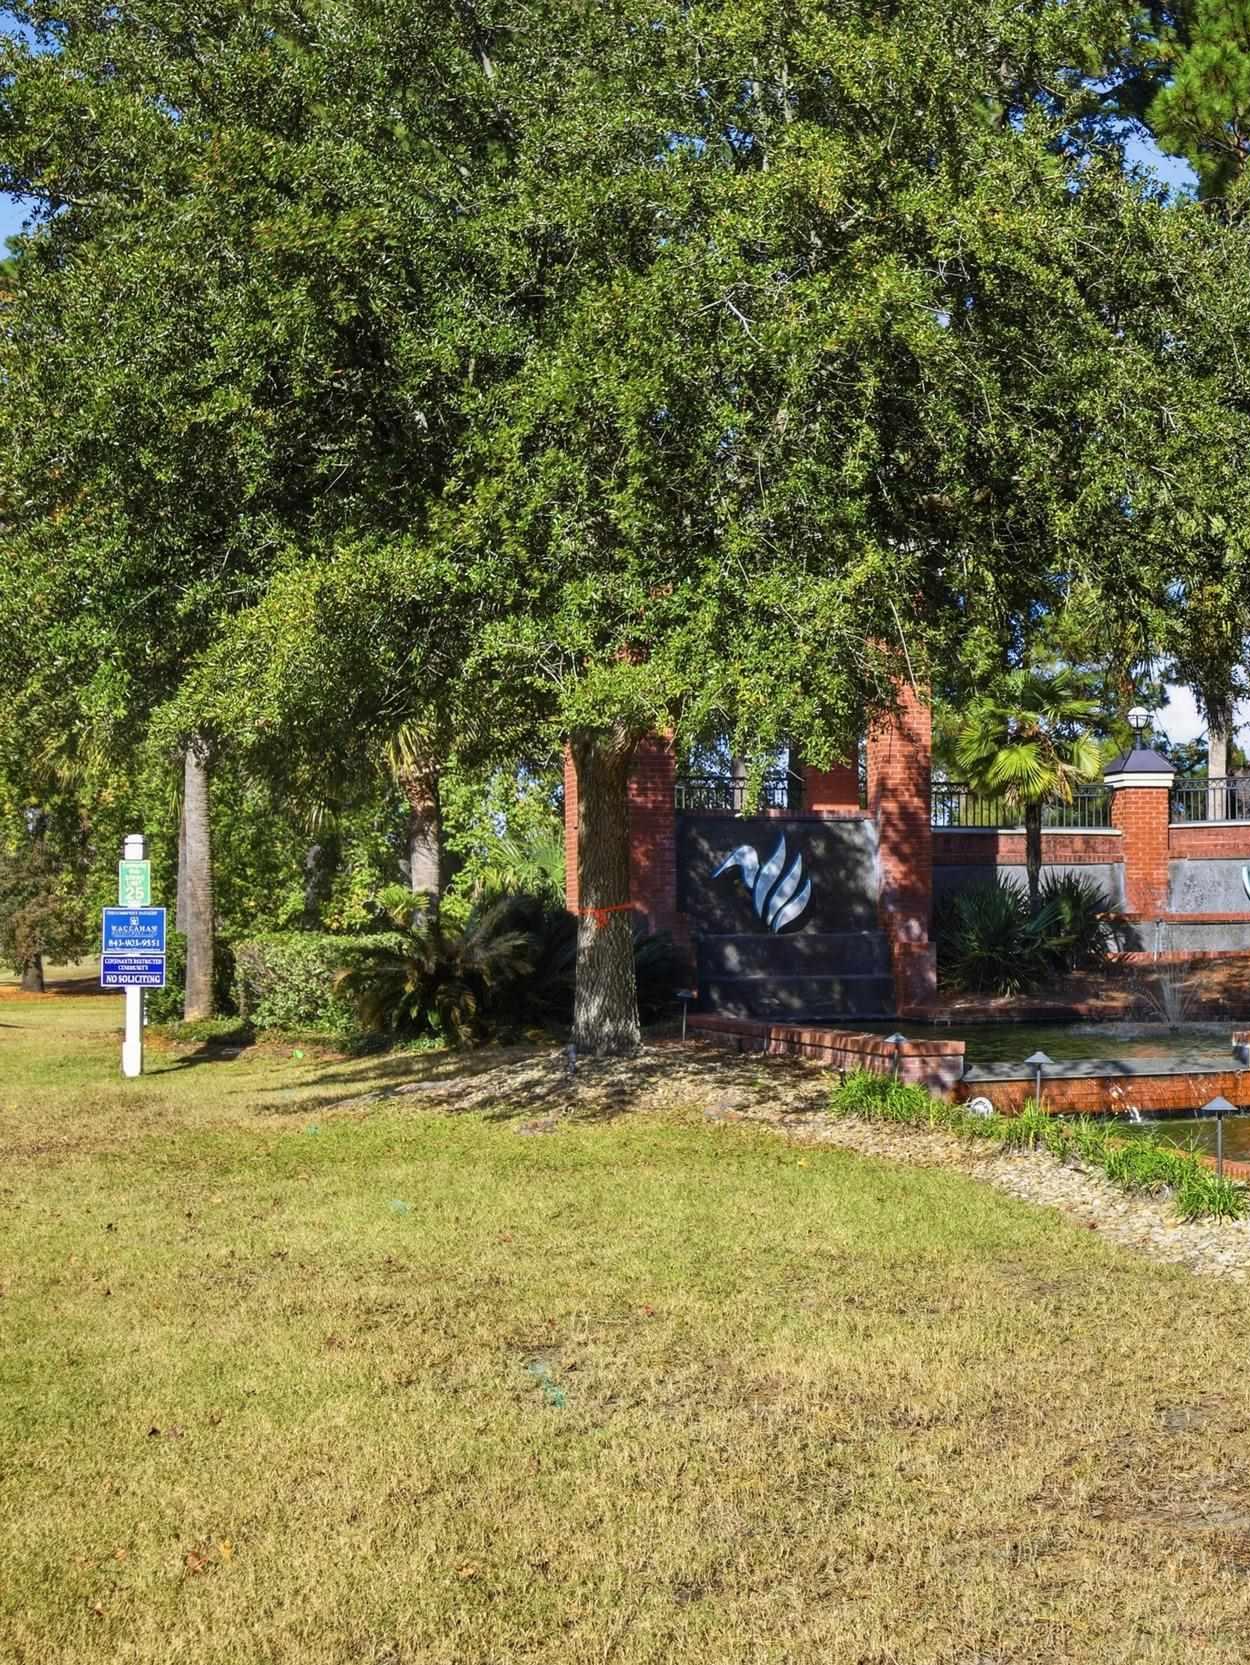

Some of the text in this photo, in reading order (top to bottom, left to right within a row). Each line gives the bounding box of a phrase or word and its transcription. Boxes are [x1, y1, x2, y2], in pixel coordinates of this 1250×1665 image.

[126, 887, 144, 900] 25
[106, 974, 161, 983] NO SOLICITING
